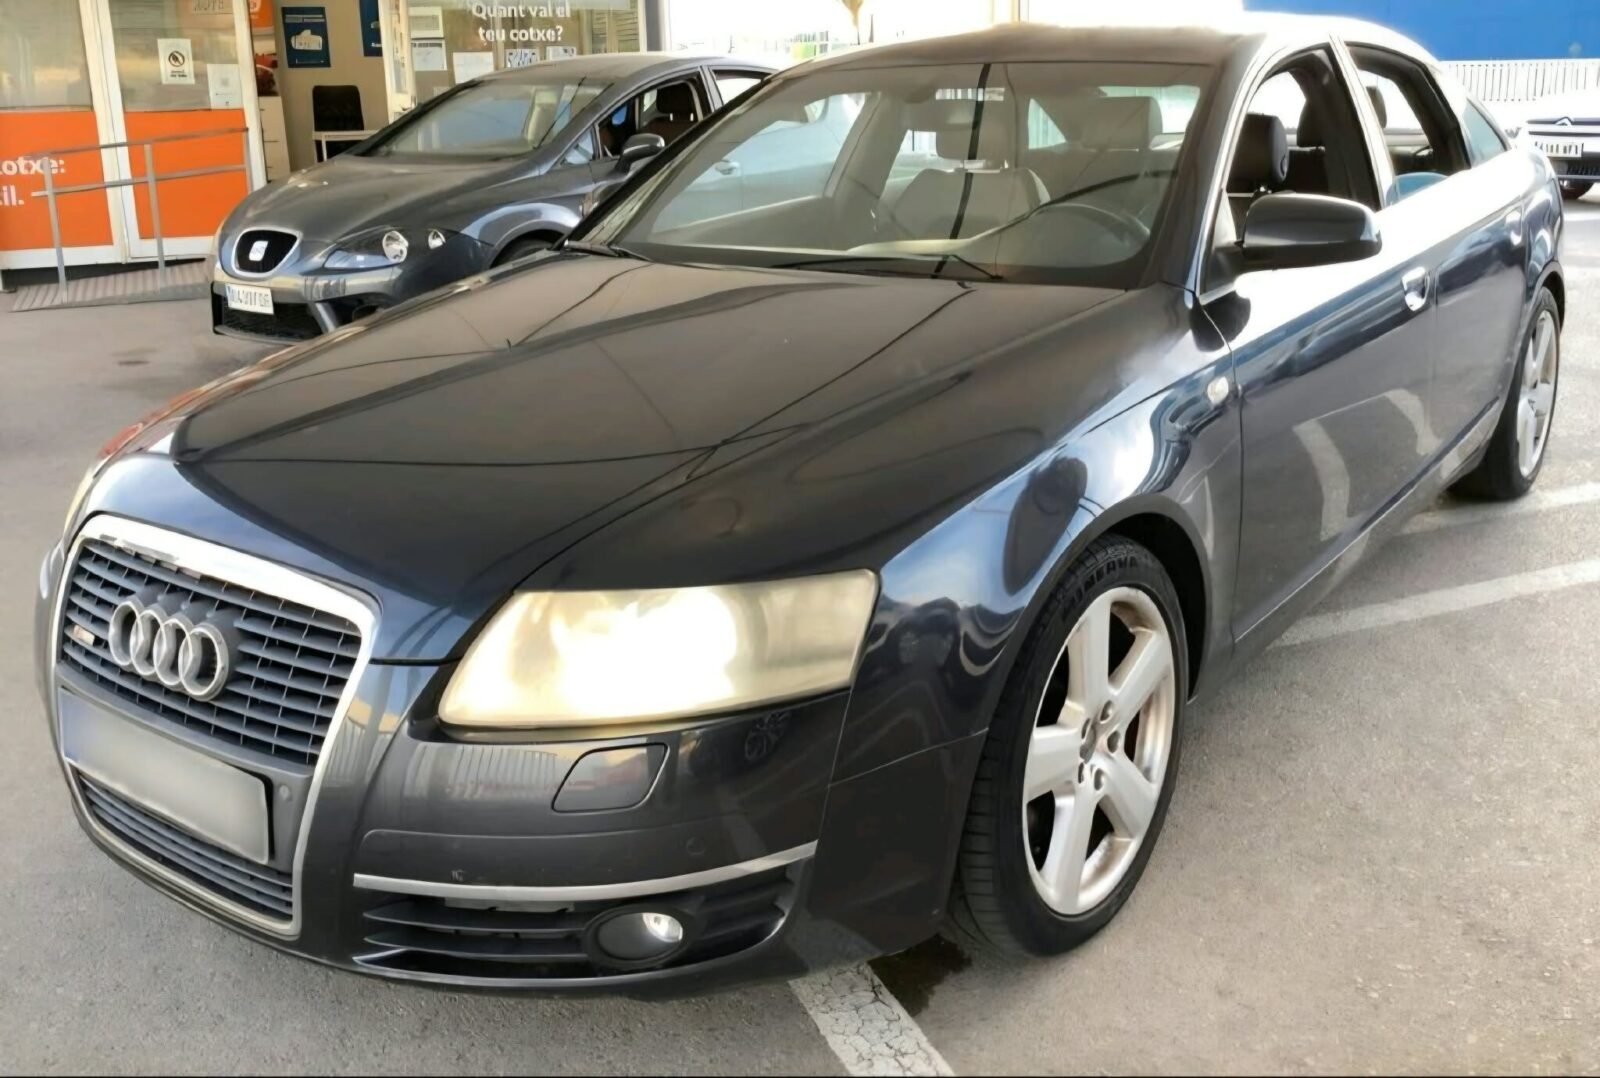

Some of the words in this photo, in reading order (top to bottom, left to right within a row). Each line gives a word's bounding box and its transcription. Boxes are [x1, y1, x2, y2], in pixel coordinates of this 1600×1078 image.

[472, 3, 526, 20] Quant
[528, 0, 553, 18] val
[556, 0, 571, 18] el
[478, 26, 506, 42] teu
[509, 24, 564, 42] cotxe?
[0, 156, 65, 176] otxe:
[0, 185, 25, 206] il.
